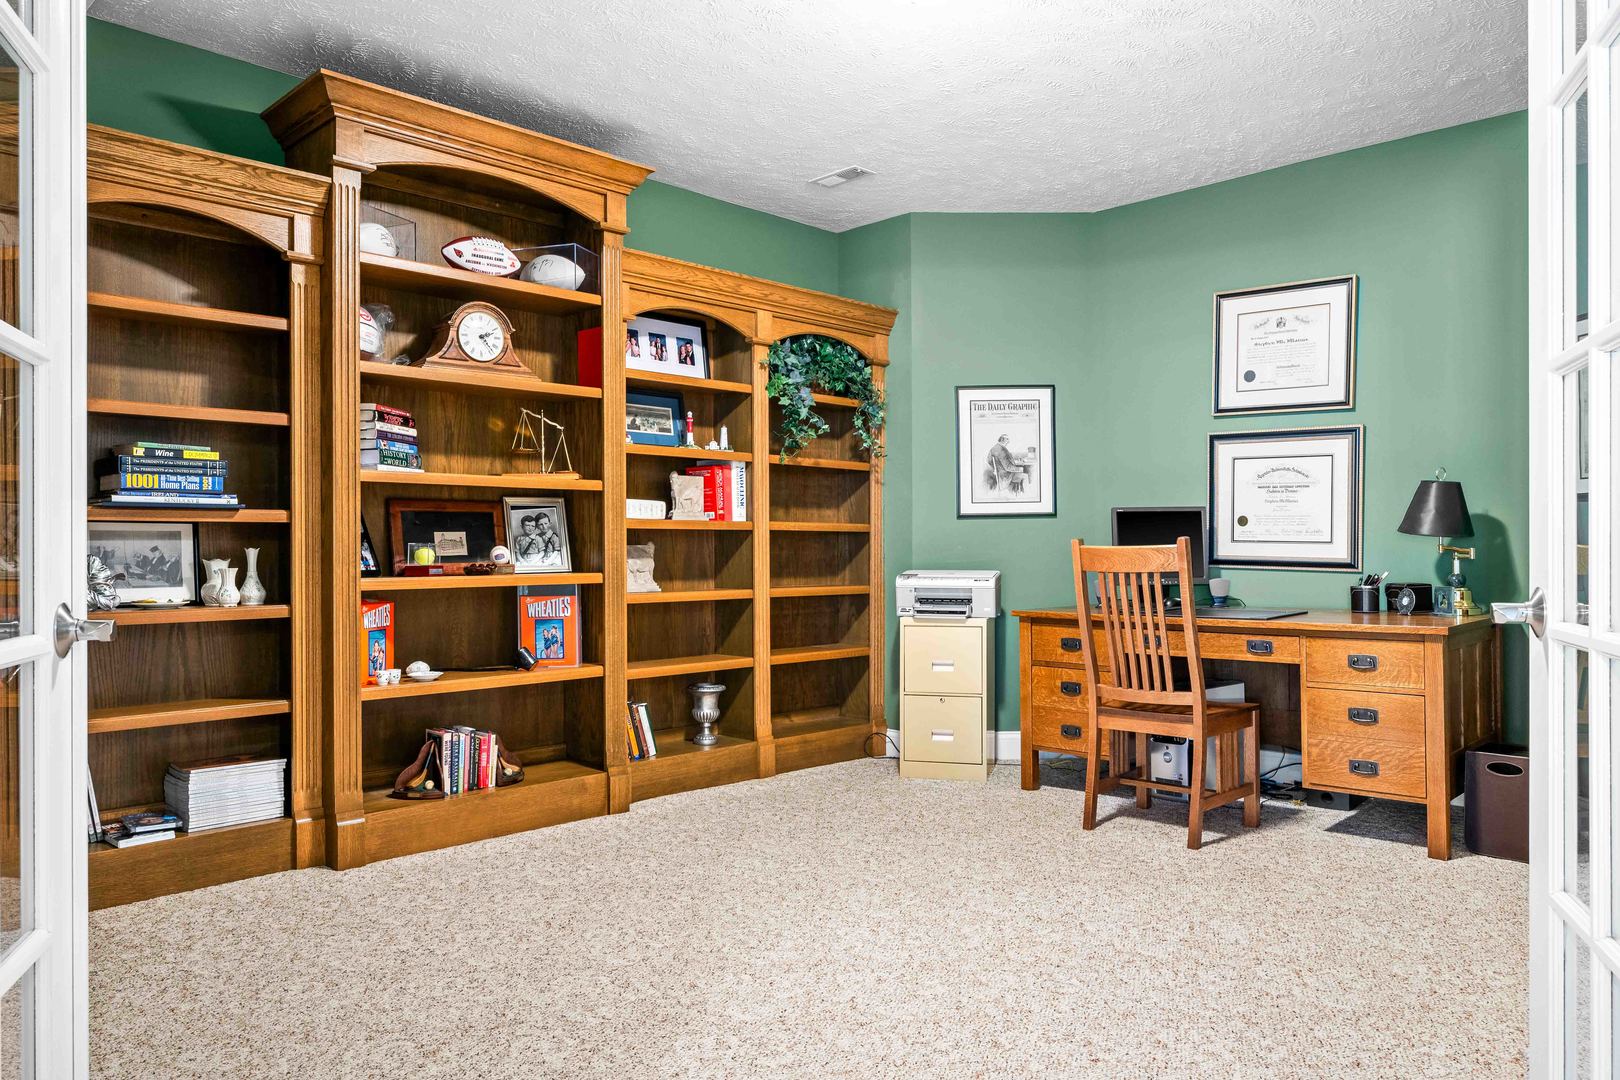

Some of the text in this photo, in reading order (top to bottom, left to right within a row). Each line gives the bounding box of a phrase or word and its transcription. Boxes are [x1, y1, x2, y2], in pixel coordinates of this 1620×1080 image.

[972, 402, 1038, 411] THE DAILY GRAPHIC
[155, 449, 174, 457] Wine
[383, 450, 407, 459] HISTORY
[387, 458, 407, 467] WORLD
[126, 473, 159, 489] 1001
[160, 481, 180, 489] Home
[181, 481, 200, 490] Plans
[527, 596, 571, 618] WHEATIES
[363, 604, 391, 628] WHEATIES
